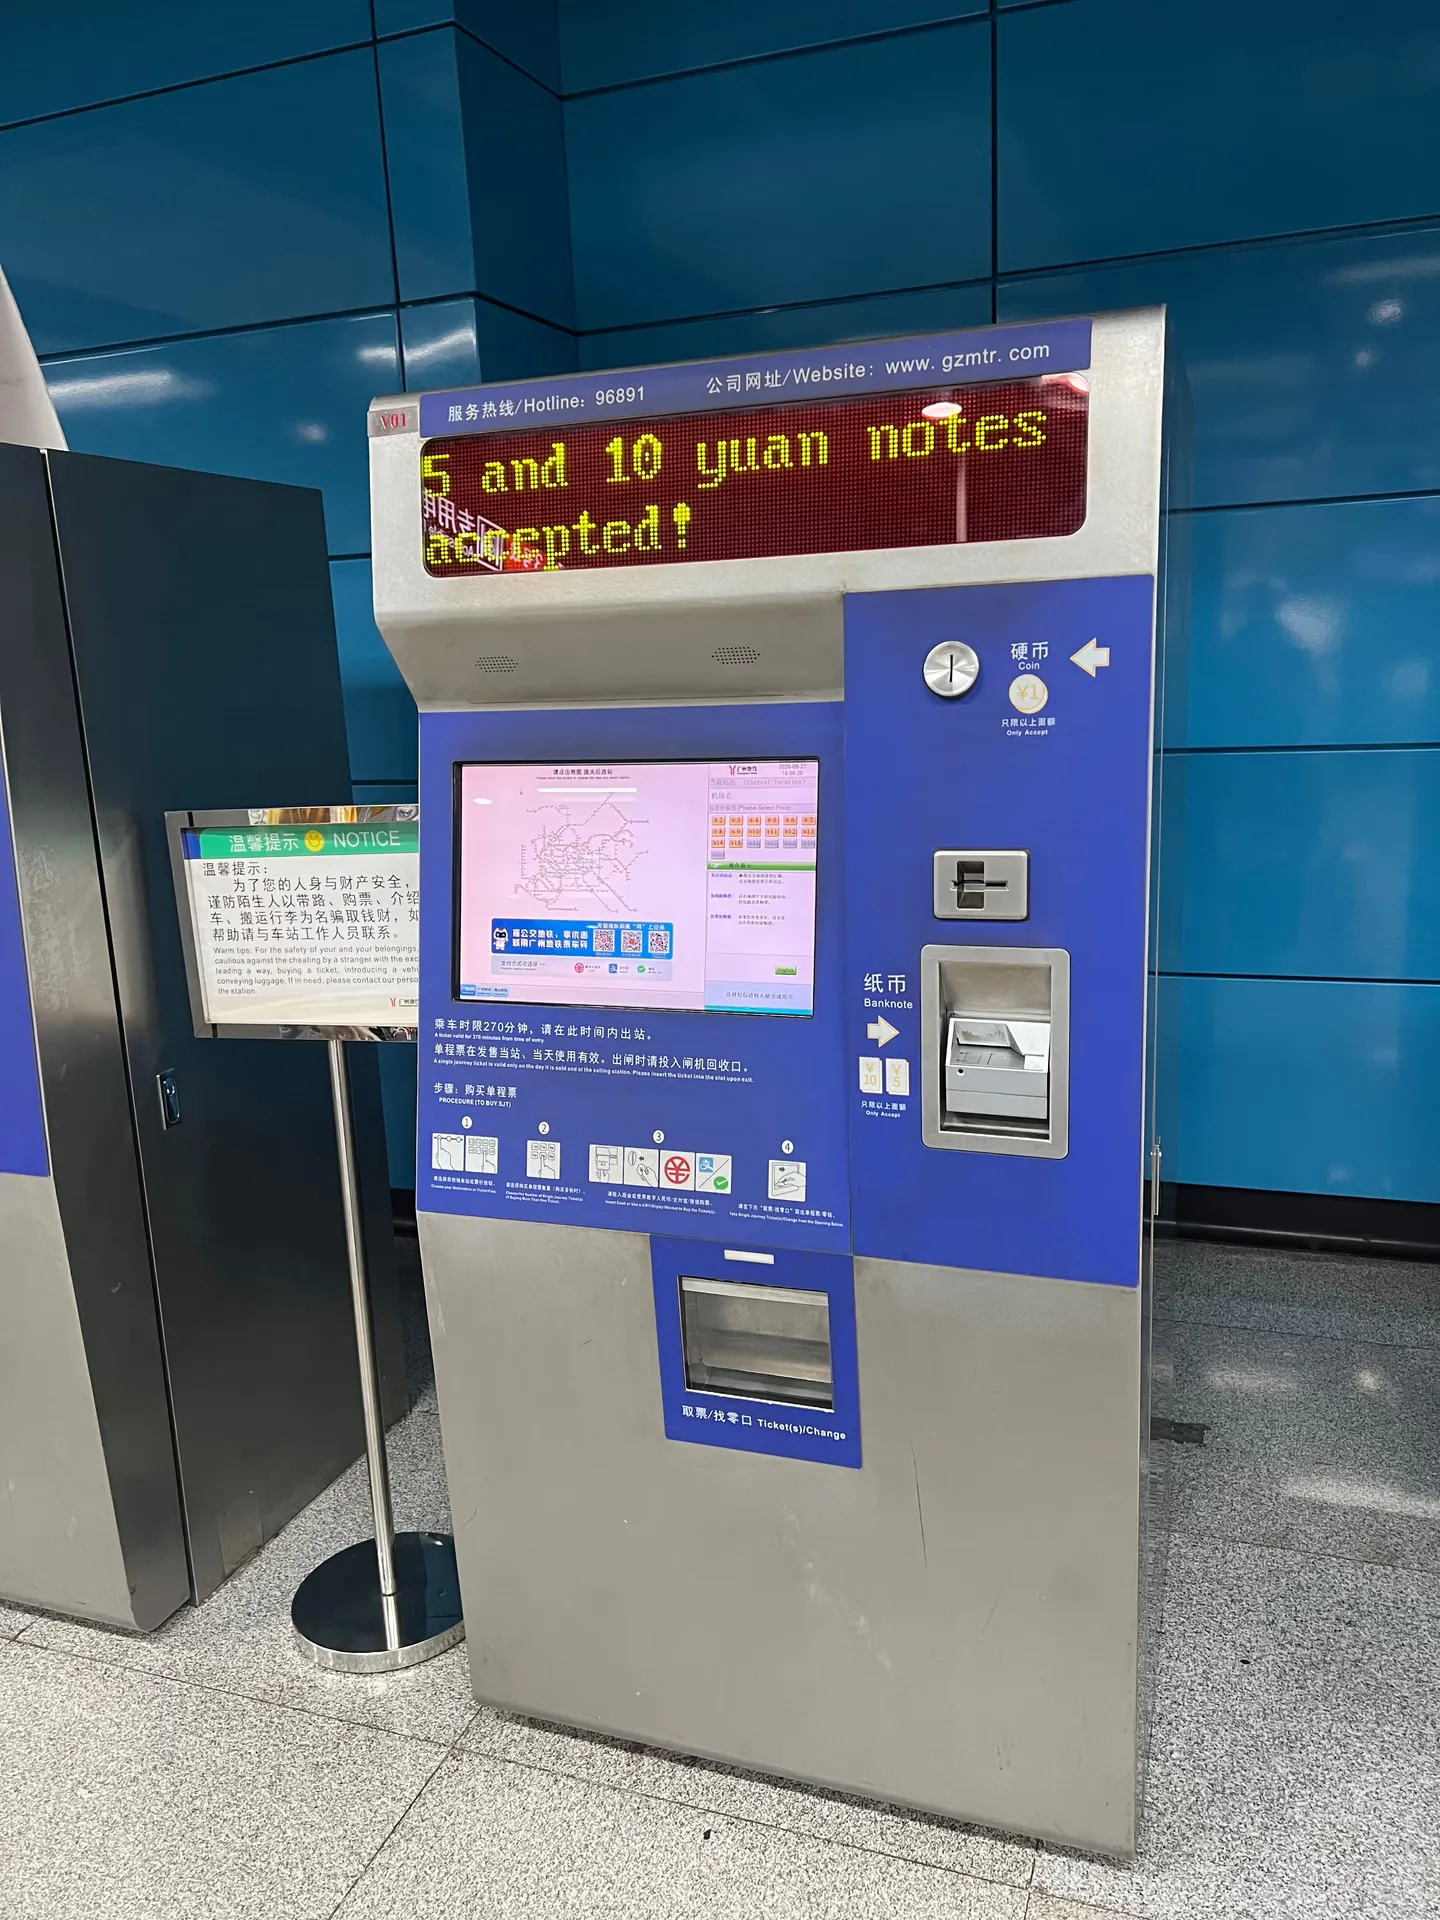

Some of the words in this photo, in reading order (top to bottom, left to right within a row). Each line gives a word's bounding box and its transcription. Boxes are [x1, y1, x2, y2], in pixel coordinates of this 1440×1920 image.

[595, 386, 645, 406] 96891
[380, 414, 408, 430] V01
[422, 454, 450, 498] 5
[482, 442, 568, 493] and
[606, 433, 662, 483] 10
[696, 430, 829, 490] yuan
[866, 410, 1048, 460] notes
[426, 502, 692, 572] accepted!
[1010, 641, 1049, 660] 硬币
[1018, 661, 1040, 670] Coin
[1016, 684, 1039, 700] ¥1
[228, 832, 299, 853] 温馨提示
[332, 830, 401, 848] NOTICE
[202, 862, 268, 877] 温馨提示：
[233, 874, 410, 893] 为了您的人身与财产安全，
[212, 925, 398, 942] 帮助请与车站工作人员联系。
[236, 947, 252, 955] tips:
[284, 946, 307, 955] safety
[320, 945, 336, 954] your
[356, 944, 372, 954] your
[246, 957, 273, 966] against
[290, 956, 320, 965] cheating
[322, 956, 332, 964] by
[340, 955, 371, 964] stranger
[215, 967, 242, 976] leading
[256, 967, 272, 976] way,
[277, 967, 302, 976] buying
[317, 966, 340, 975] ticket,
[344, 966, 387, 975] introducing
[217, 978, 253, 986] conveying
[254, 977, 286, 986] luggage.
[303, 977, 324, 986] need,
[326, 976, 350, 985] please
[864, 972, 906, 994] 纸币
[864, 998, 913, 1009] Banknote
[434, 1018, 652, 1040] 乘车时限270分钟，请在此时间内出站。
[864, 1074, 876, 1085] 10
[893, 1077, 900, 1087] 5
[682, 1405, 752, 1426] 取票/找零口
[757, 1418, 846, 1440] Ticket(s)/Change
